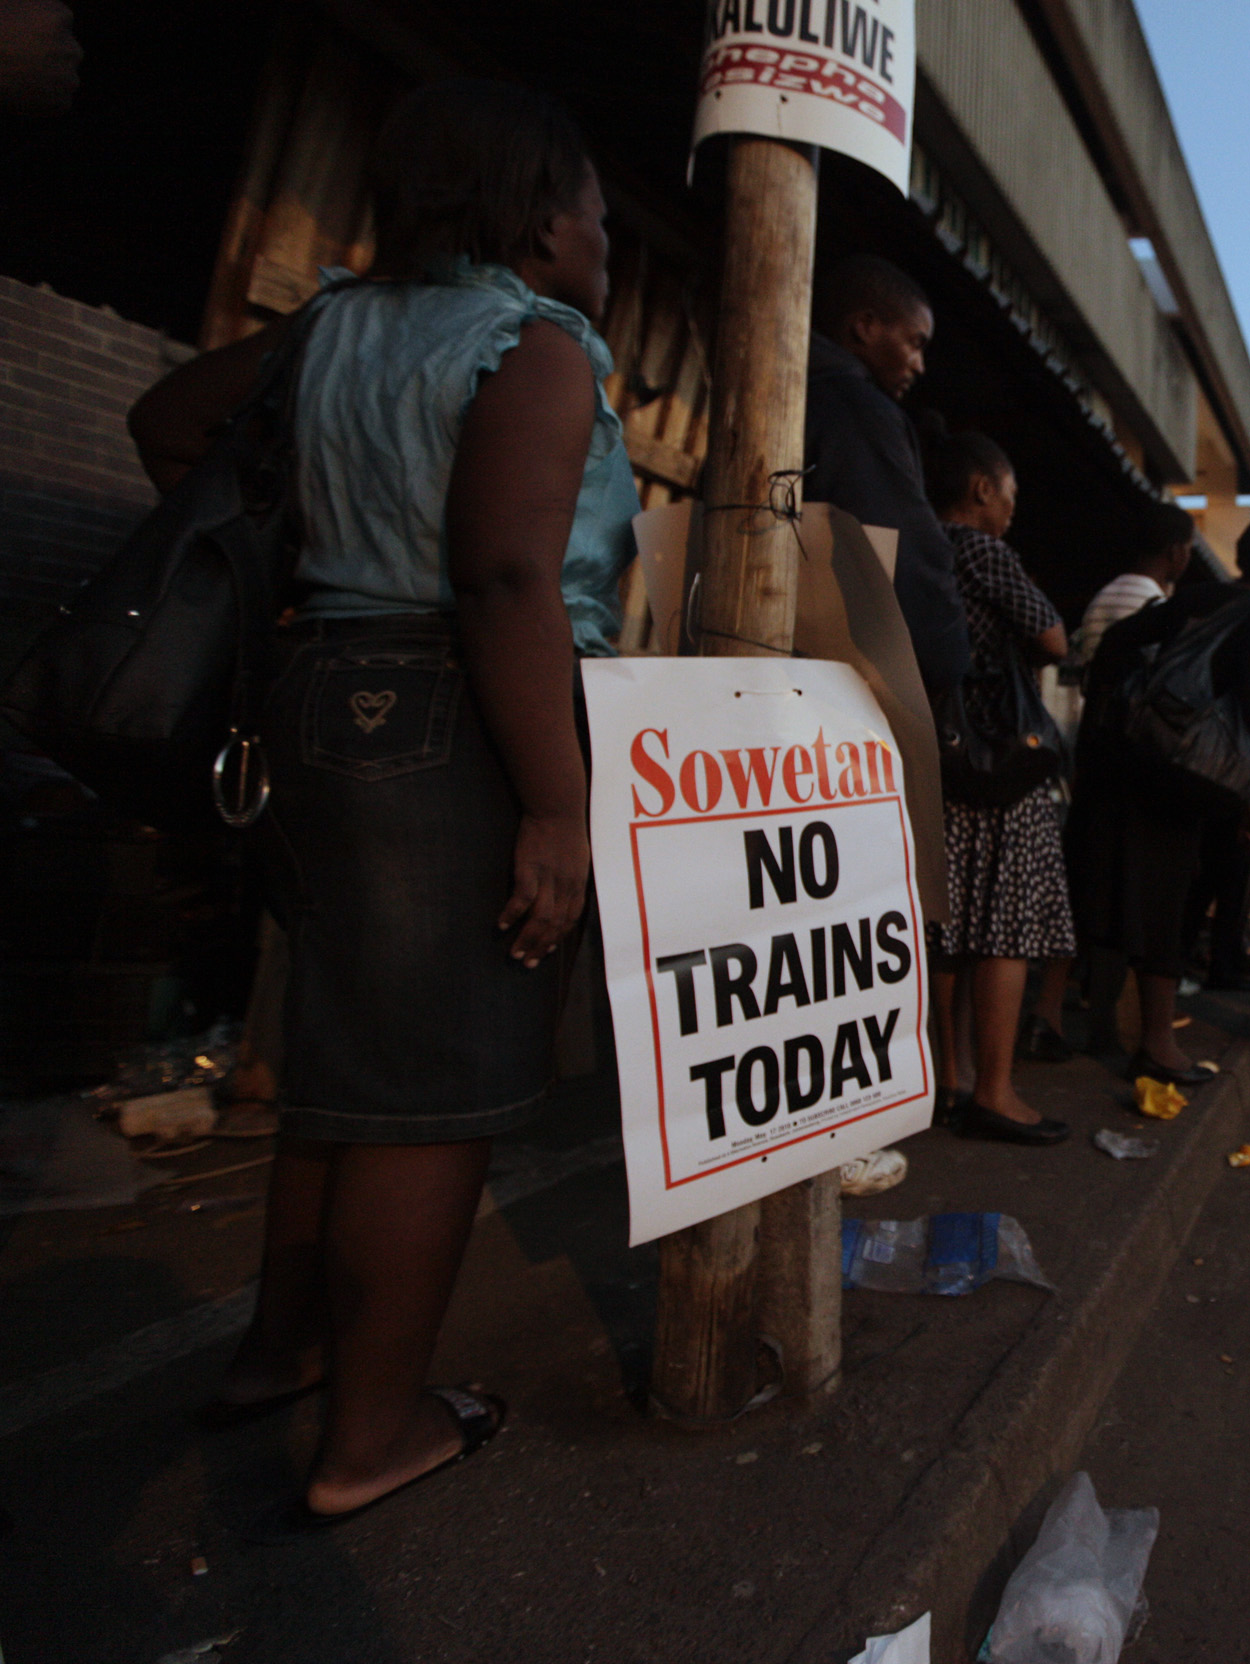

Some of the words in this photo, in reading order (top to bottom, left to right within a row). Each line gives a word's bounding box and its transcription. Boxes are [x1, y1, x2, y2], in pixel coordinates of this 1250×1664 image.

[629, 726, 898, 818] Sowetan
[743, 821, 840, 910] NO
[656, 911, 911, 1037] TRAINS
[689, 1008, 901, 1141] TODAY
